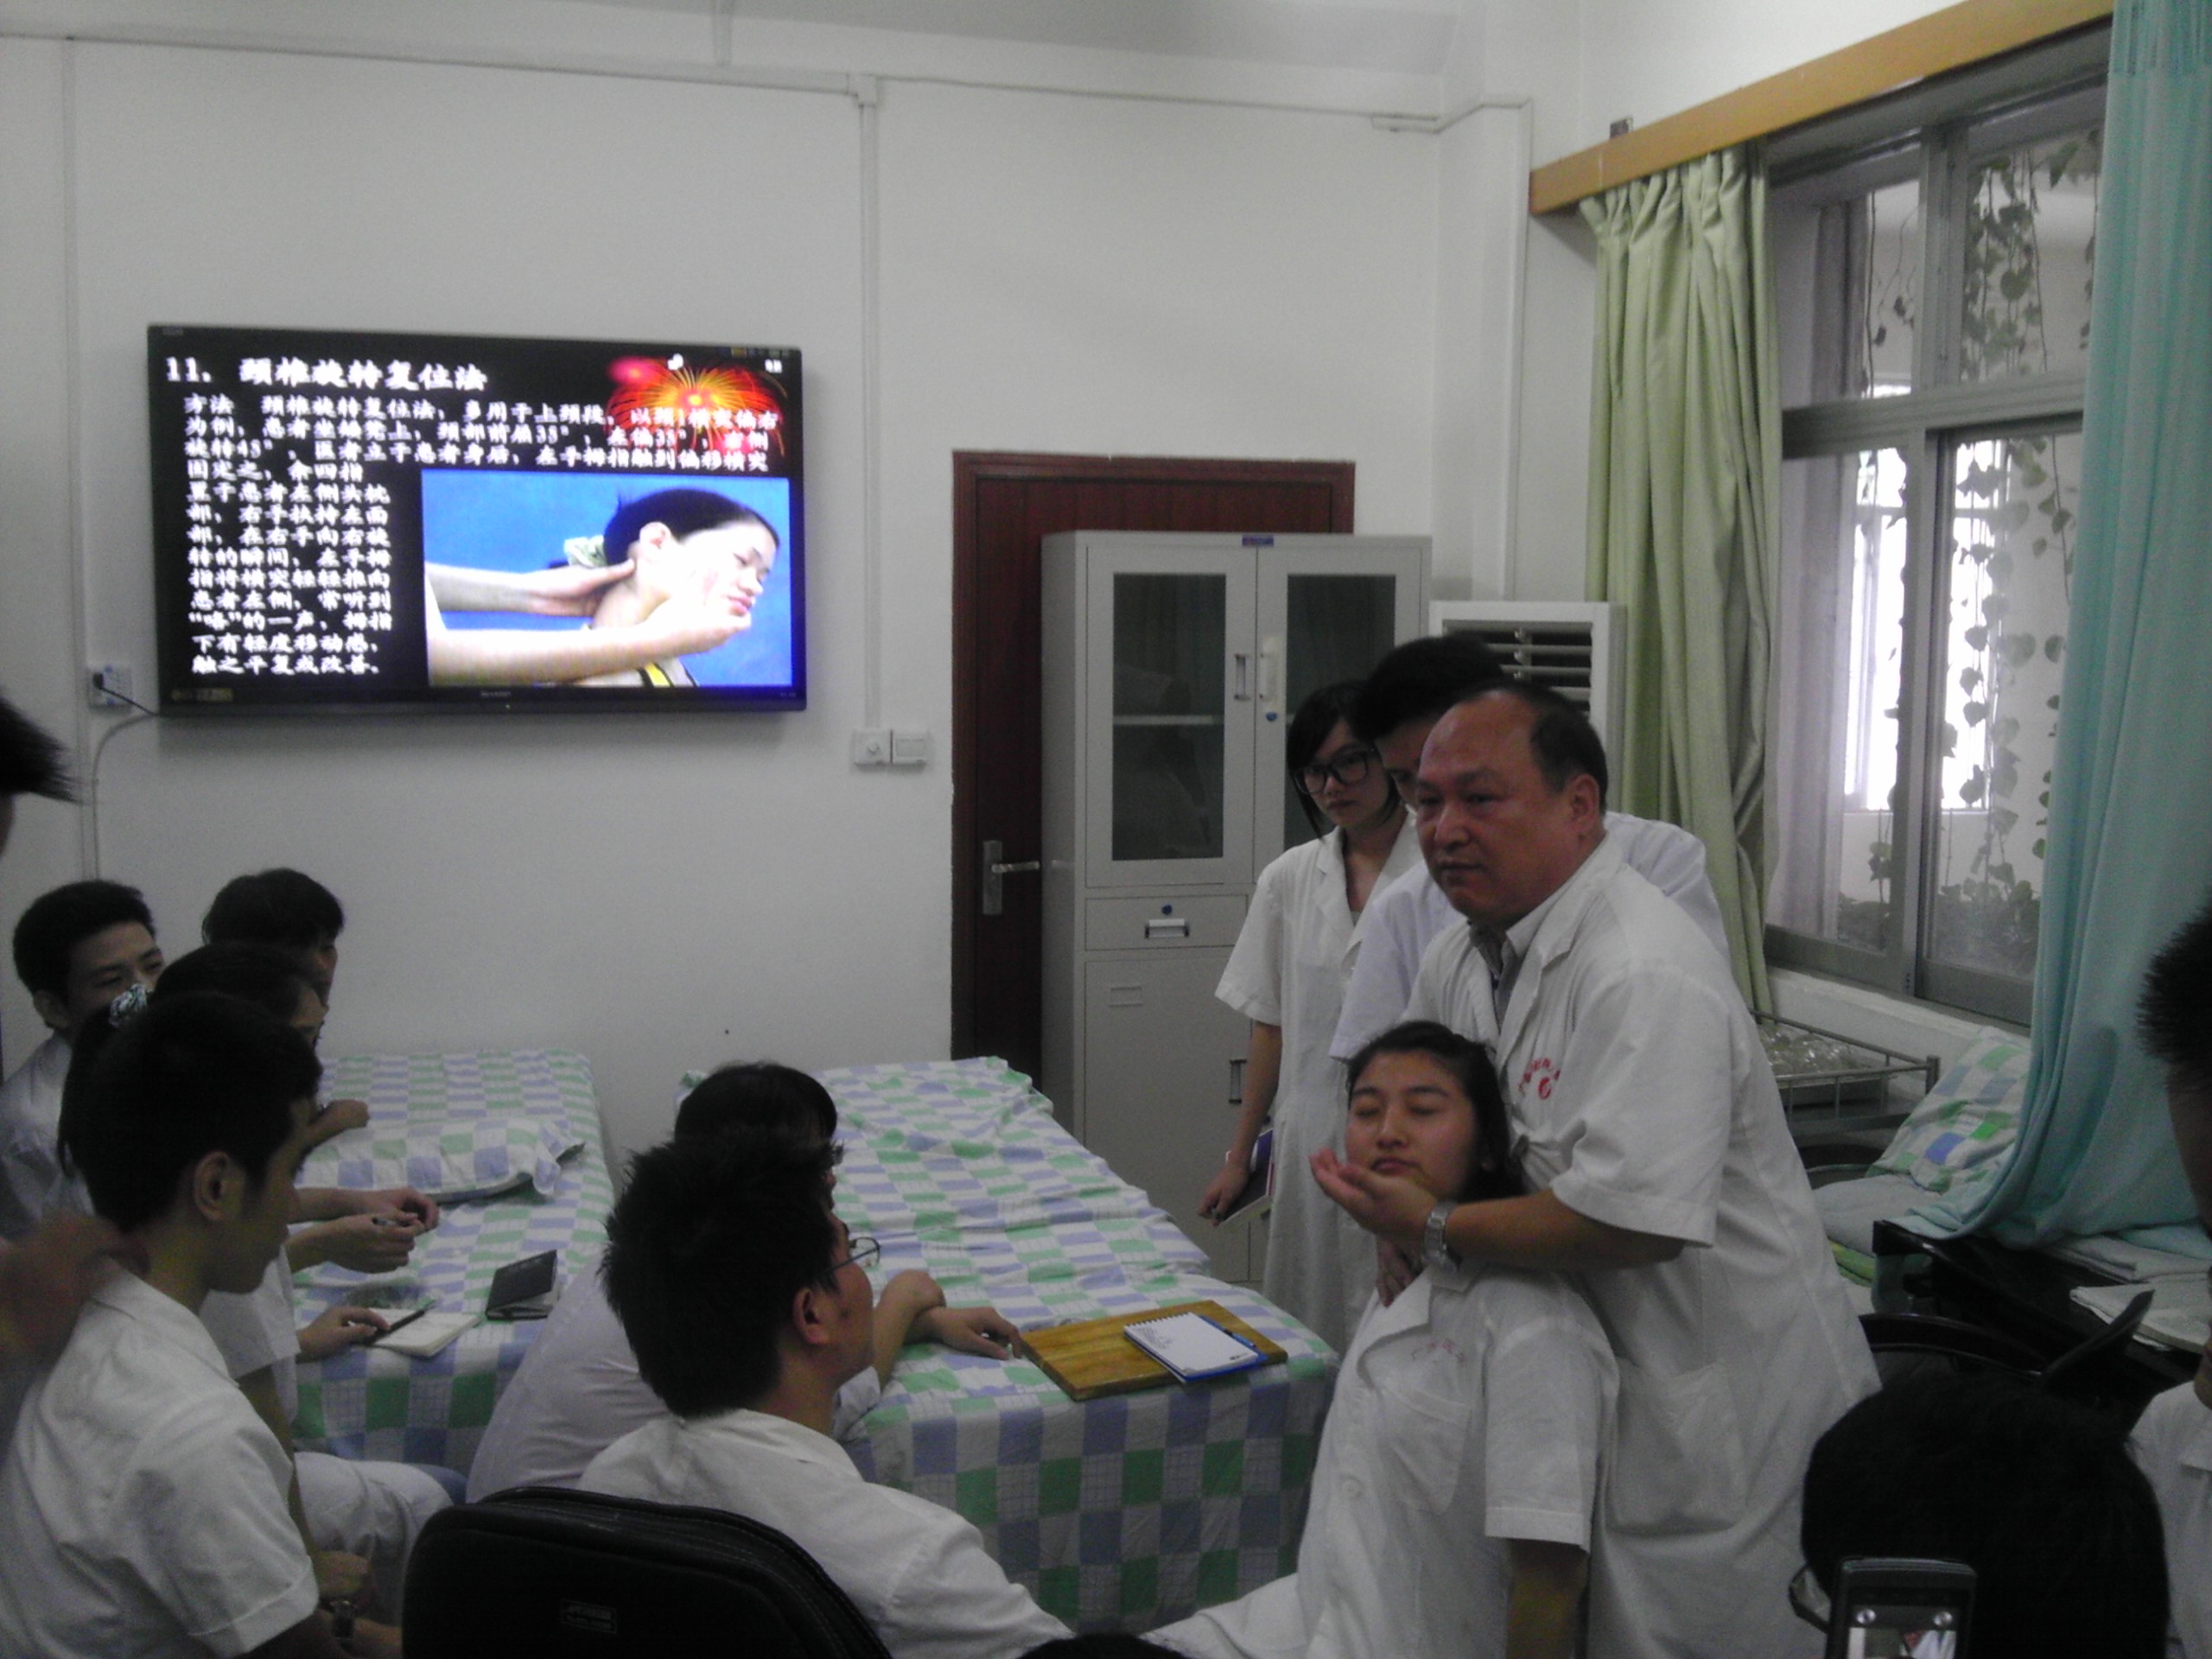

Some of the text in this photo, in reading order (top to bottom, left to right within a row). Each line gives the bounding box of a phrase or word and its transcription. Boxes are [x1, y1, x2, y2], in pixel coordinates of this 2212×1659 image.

[238, 357, 487, 391] 颈椎旋转复位法
[186, 480, 391, 504] 置于患者左侧头枕
[188, 568, 391, 590] 指将横突轻轻推向
